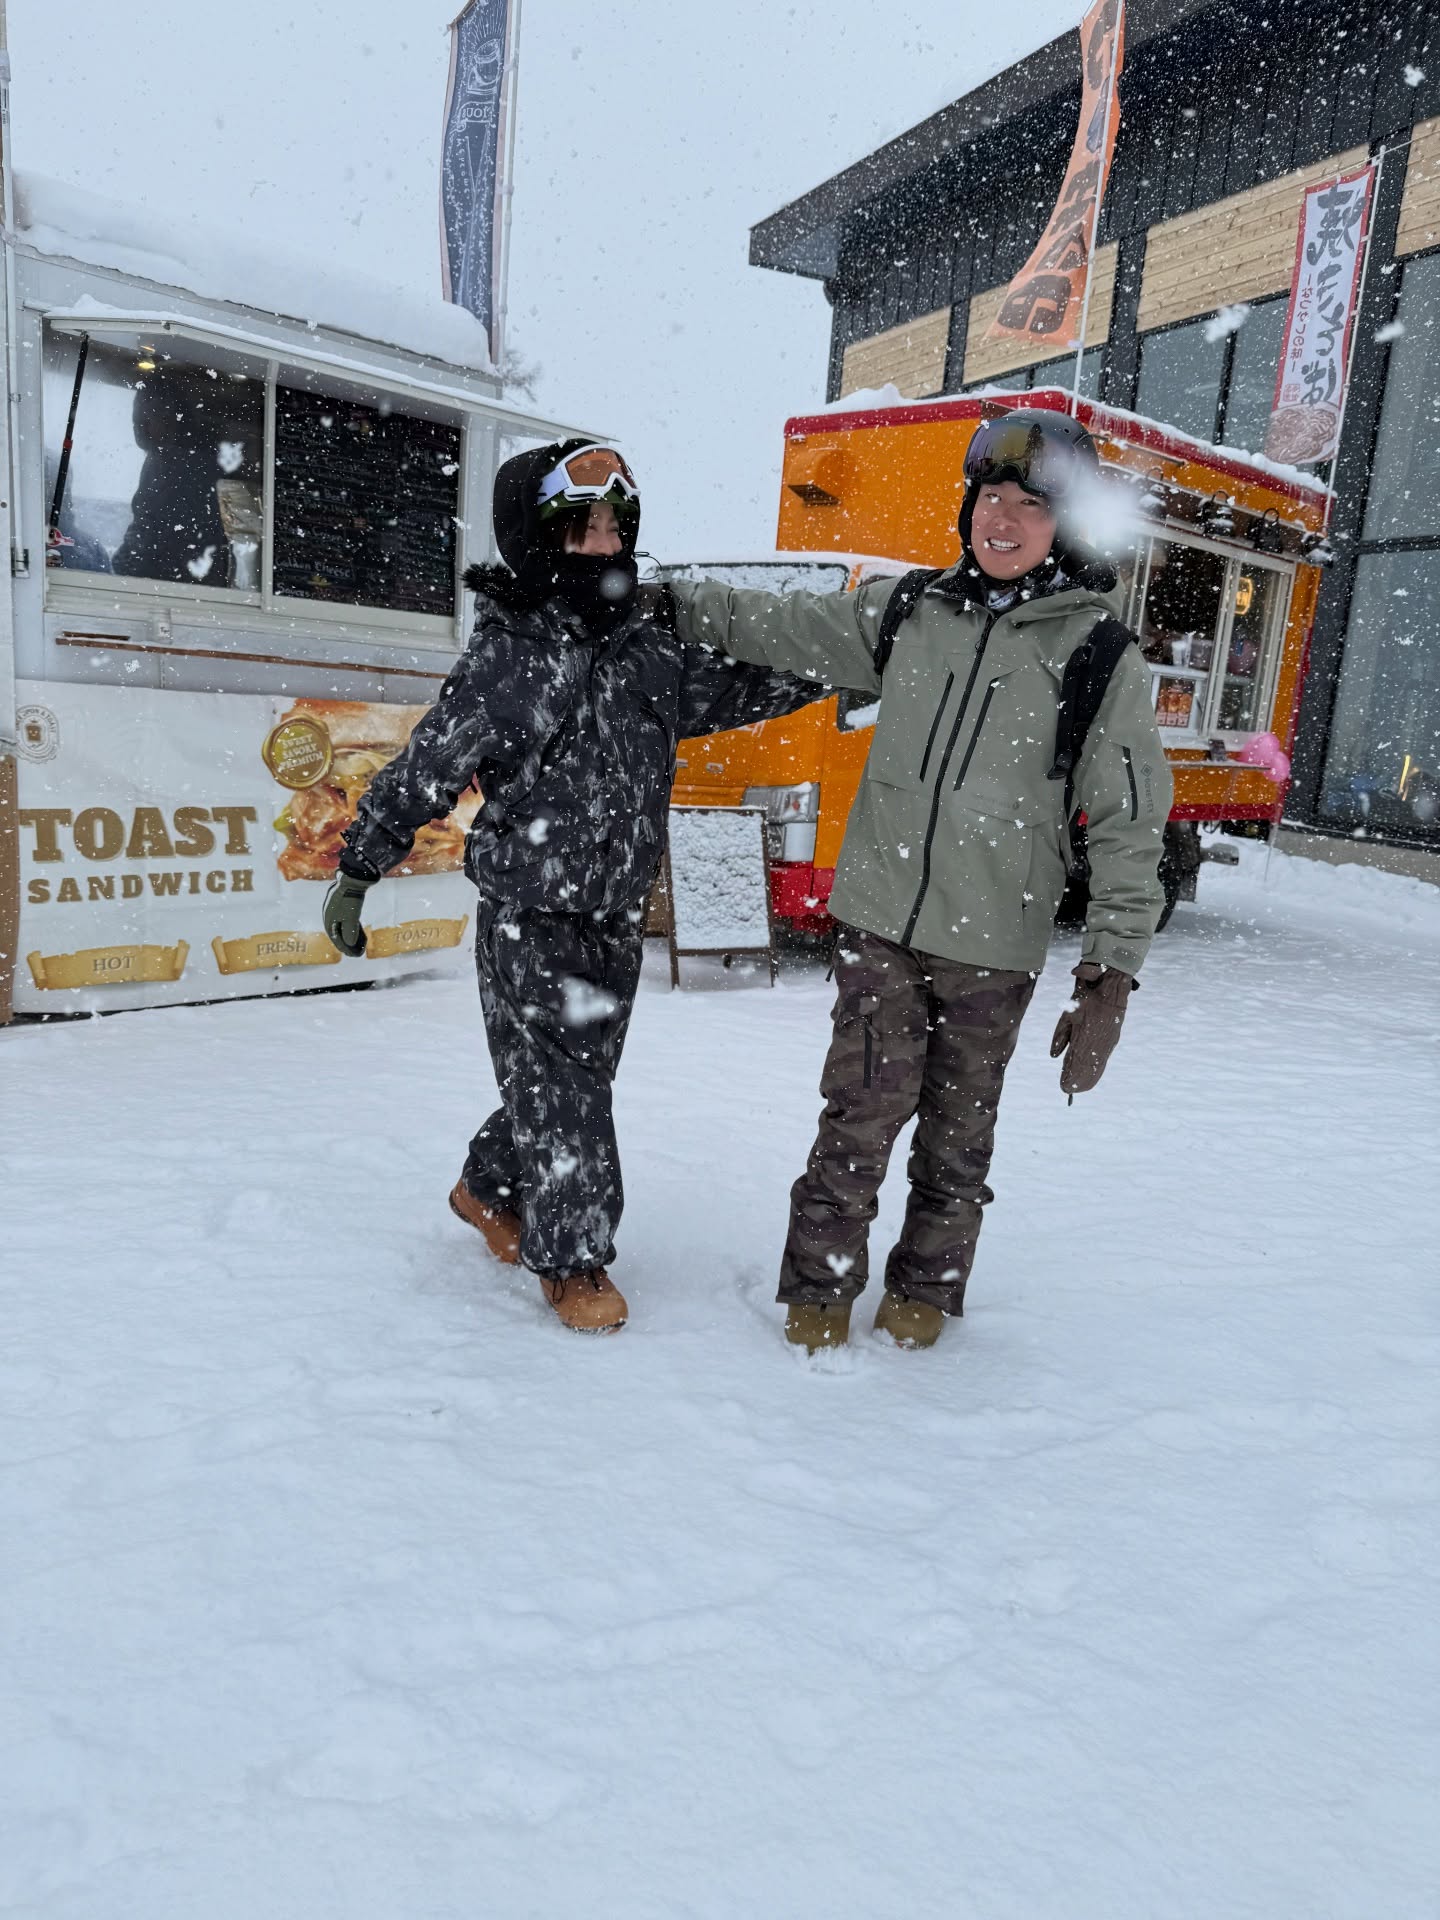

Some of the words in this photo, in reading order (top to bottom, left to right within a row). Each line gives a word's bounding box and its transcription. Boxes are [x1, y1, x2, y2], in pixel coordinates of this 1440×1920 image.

[18, 807, 257, 863] TOAST
[27, 868, 255, 904] SANDWICH
[392, 925, 443, 944] TOASTY
[256, 940, 308, 957] FRESH
[92, 954, 136, 972] HOT
